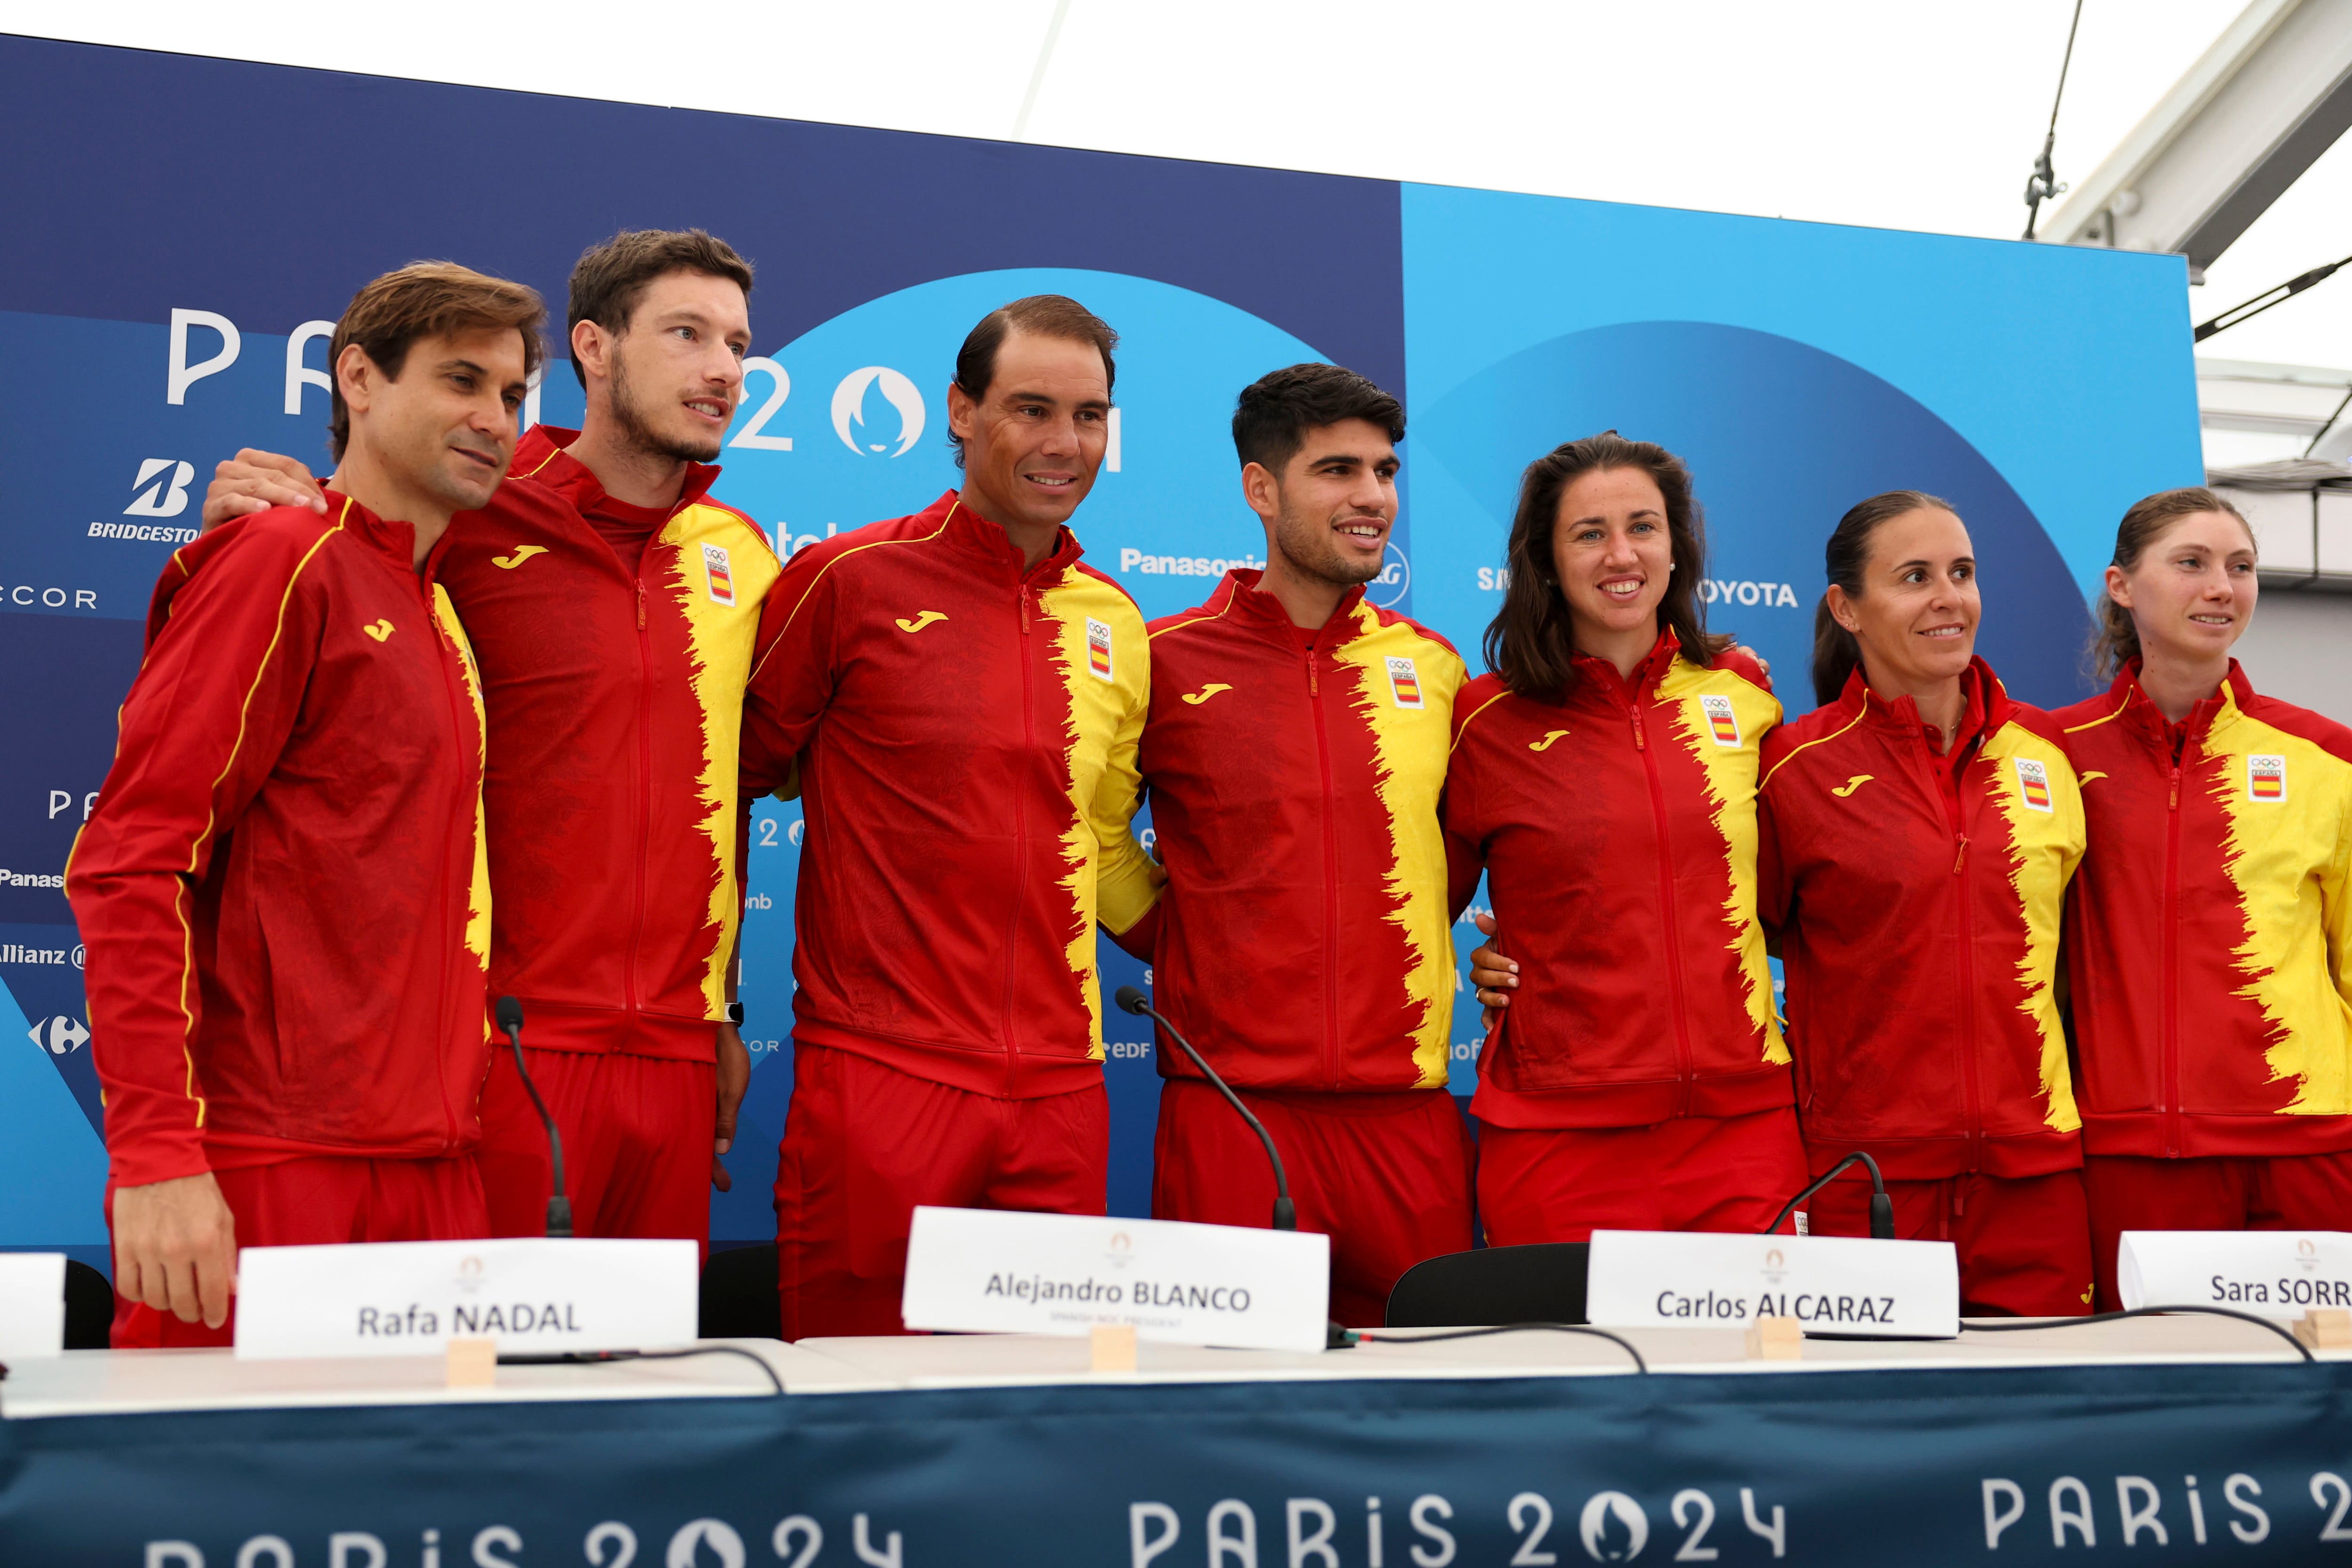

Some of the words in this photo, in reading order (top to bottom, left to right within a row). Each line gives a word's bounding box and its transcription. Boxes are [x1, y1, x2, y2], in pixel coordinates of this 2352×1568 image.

[87, 522, 201, 543] BRIDGESTO
[1091, 638, 1106, 646] ESPAÑA
[985, 1273, 1122, 1304] Alejandro
[1134, 1281, 1251, 1311] BLANCO
[1656, 1290, 1747, 1319] Carlos
[1756, 1293, 1894, 1322] ALCARAZ
[2212, 1275, 2268, 1303] Sara
[2278, 1278, 2352, 1306] SORR
[358, 1304, 438, 1336] Rafa
[453, 1304, 581, 1333] NADAL
